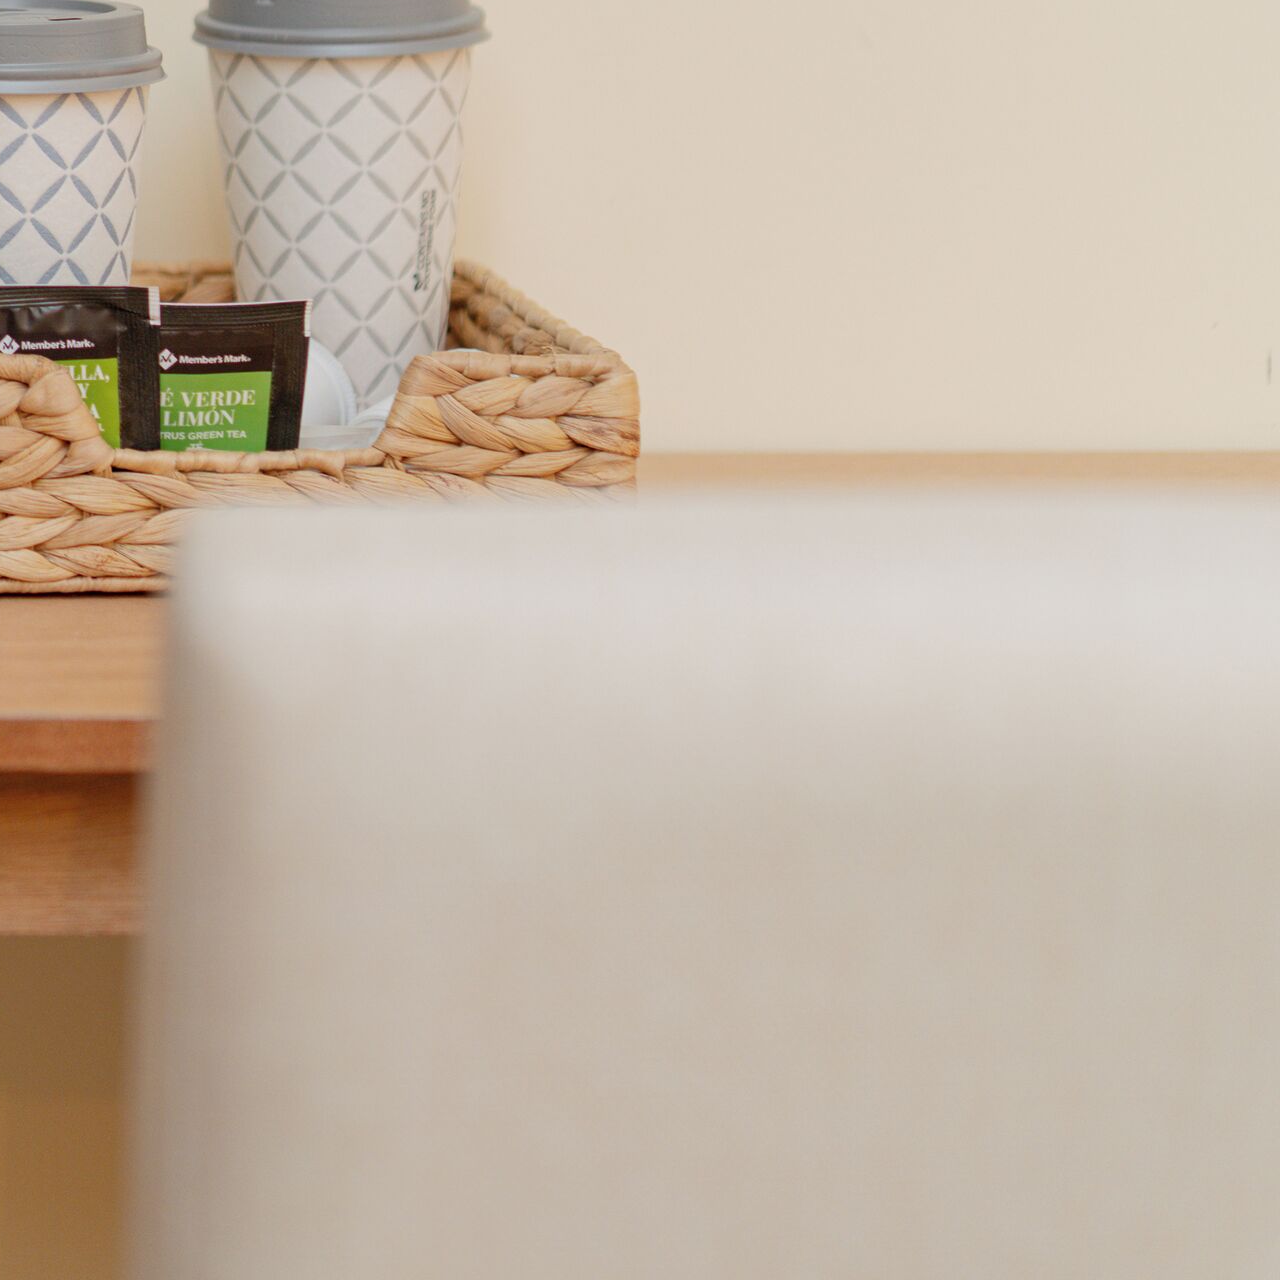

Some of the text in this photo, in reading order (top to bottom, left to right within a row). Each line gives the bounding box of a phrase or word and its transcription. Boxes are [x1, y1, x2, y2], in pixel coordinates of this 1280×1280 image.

[21, 340, 66, 351] Member's
[179, 355, 223, 364] Member's
[160, 387, 256, 408] É VERDE
[163, 406, 236, 427] LIMÓN
[160, 430, 247, 440] TRUS GREEN TEA
